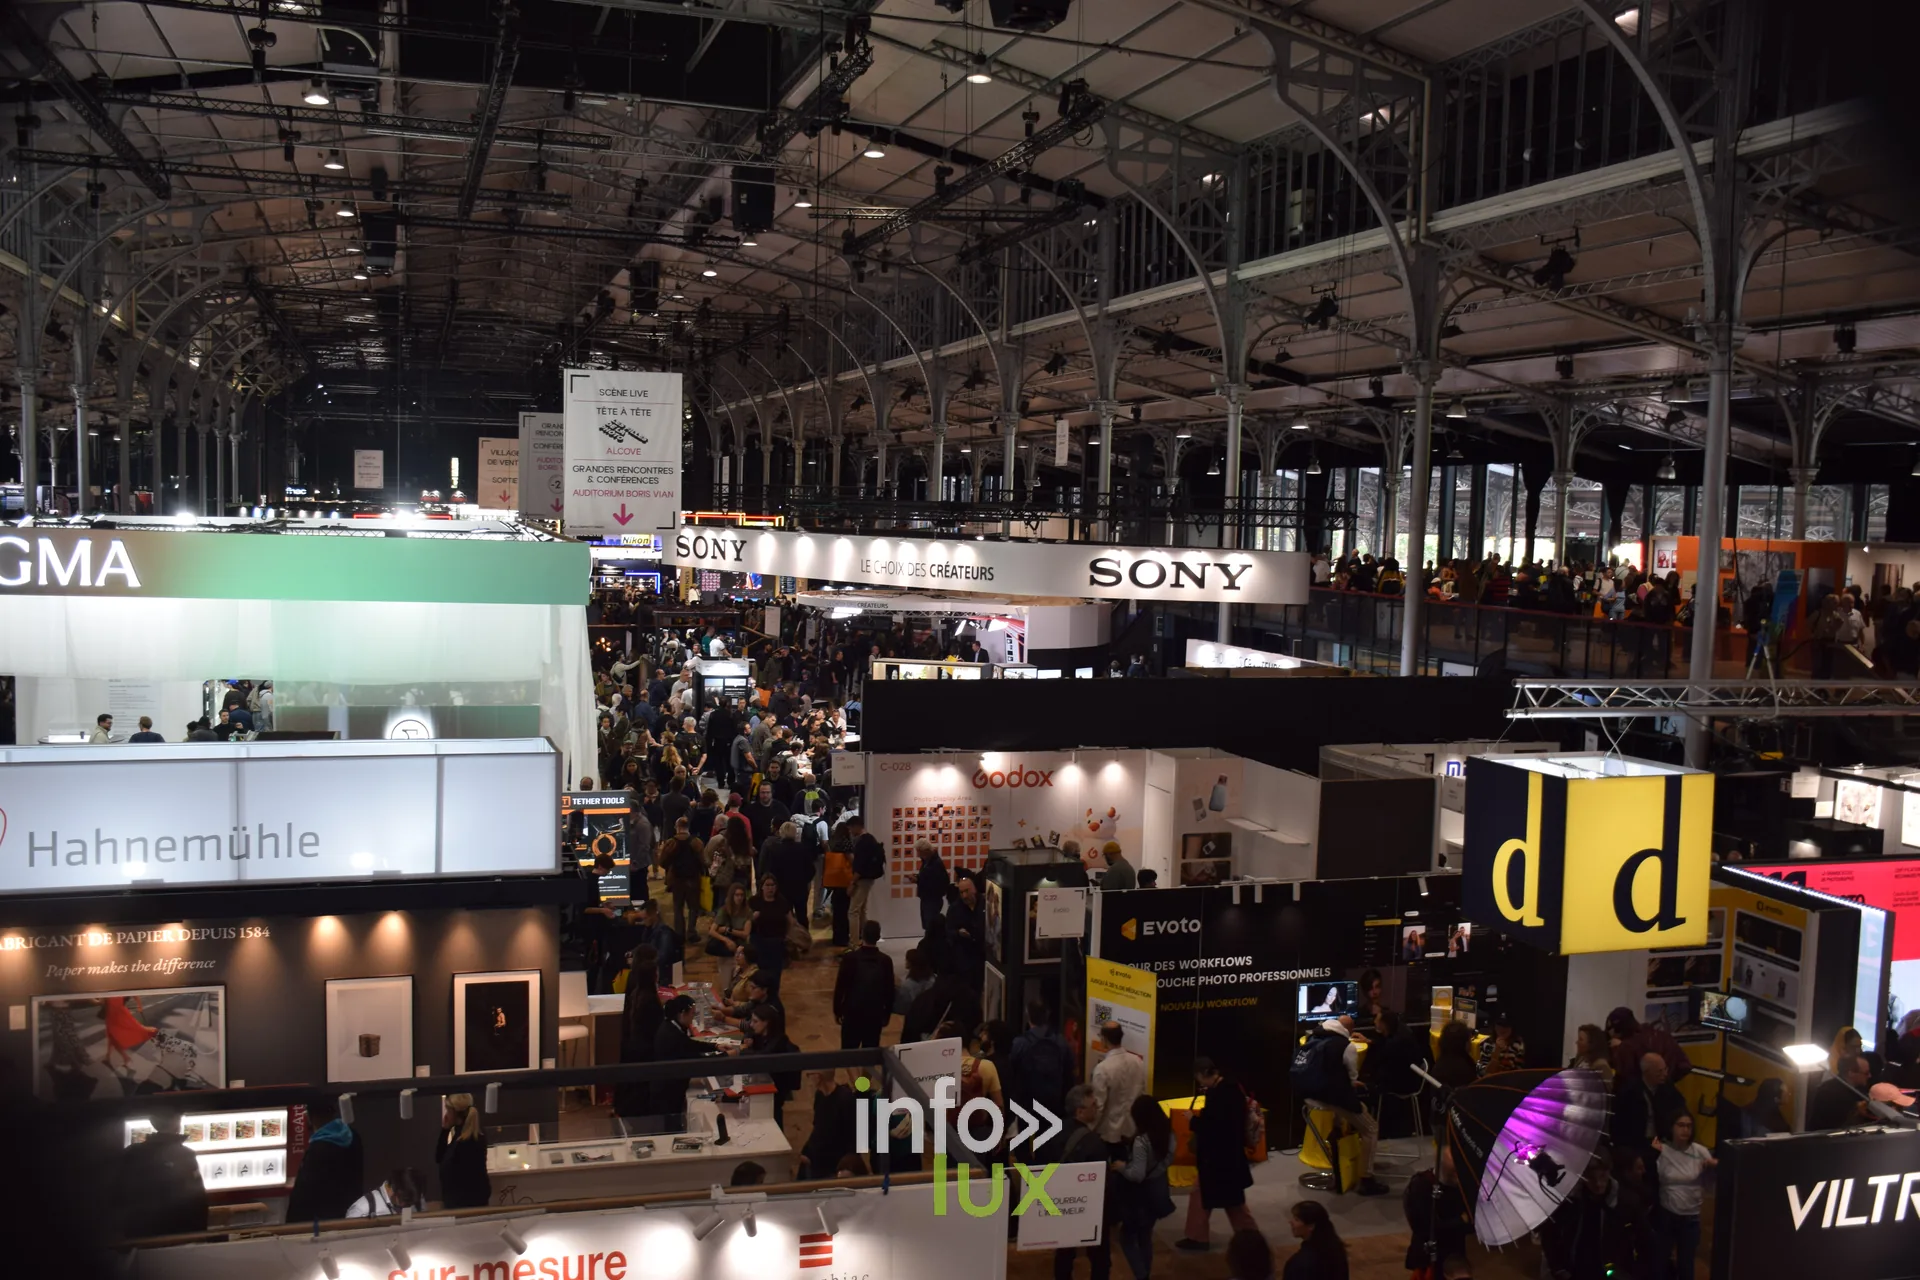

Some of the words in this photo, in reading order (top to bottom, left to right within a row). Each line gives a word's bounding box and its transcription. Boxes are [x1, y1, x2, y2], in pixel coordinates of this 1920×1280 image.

[599, 389, 627, 397] SCÈNE
[597, 407, 618, 416] TÊTE
[630, 407, 651, 417] TÊTE
[606, 447, 641, 456] ALCOVE
[572, 465, 615, 473] GRANDES
[617, 466, 674, 475] RENCONTRES
[597, 475, 659, 485] CONFÉRENCES
[285, 486, 307, 495] fnac
[573, 489, 624, 498] AUDITORIUM
[626, 490, 651, 498] BORIS
[653, 490, 674, 498] VIAN
[622, 536, 649, 544] Nikon
[676, 535, 747, 562] SONY
[860, 558, 871, 573] LE
[875, 559, 904, 576] CHOIX
[908, 561, 927, 578] DES
[929, 562, 994, 581] CRÉATEURS
[1089, 557, 1253, 591] SONY
[880, 762, 912, 772] C-028
[972, 764, 1055, 789] Godox
[28, 822, 320, 867] Hahnemühle
[0, 933, 86, 949] BRICANT
[89, 932, 113, 946] DE
[116, 930, 175, 945] PAPIER
[178, 927, 236, 942] DEPUIS
[239, 926, 271, 939] 1584
[45, 964, 85, 981] Paper
[87, 961, 128, 975] makes
[131, 959, 151, 973] the
[153, 957, 216, 975] difference
[1154, 960, 1175, 971] DES
[1179, 956, 1253, 970] WORKFLOWS
[1157, 976, 1196, 989] OUCHE
[1198, 974, 1237, 986] PHOTO
[1240, 967, 1332, 983] PROFESSIONNELS
[1161, 1001, 1203, 1012] NOUVEAU
[1206, 997, 1258, 1008] WORKFLOW
[292, 1104, 305, 1154] FineArt
[1786, 1171, 1920, 1232] VILTR
